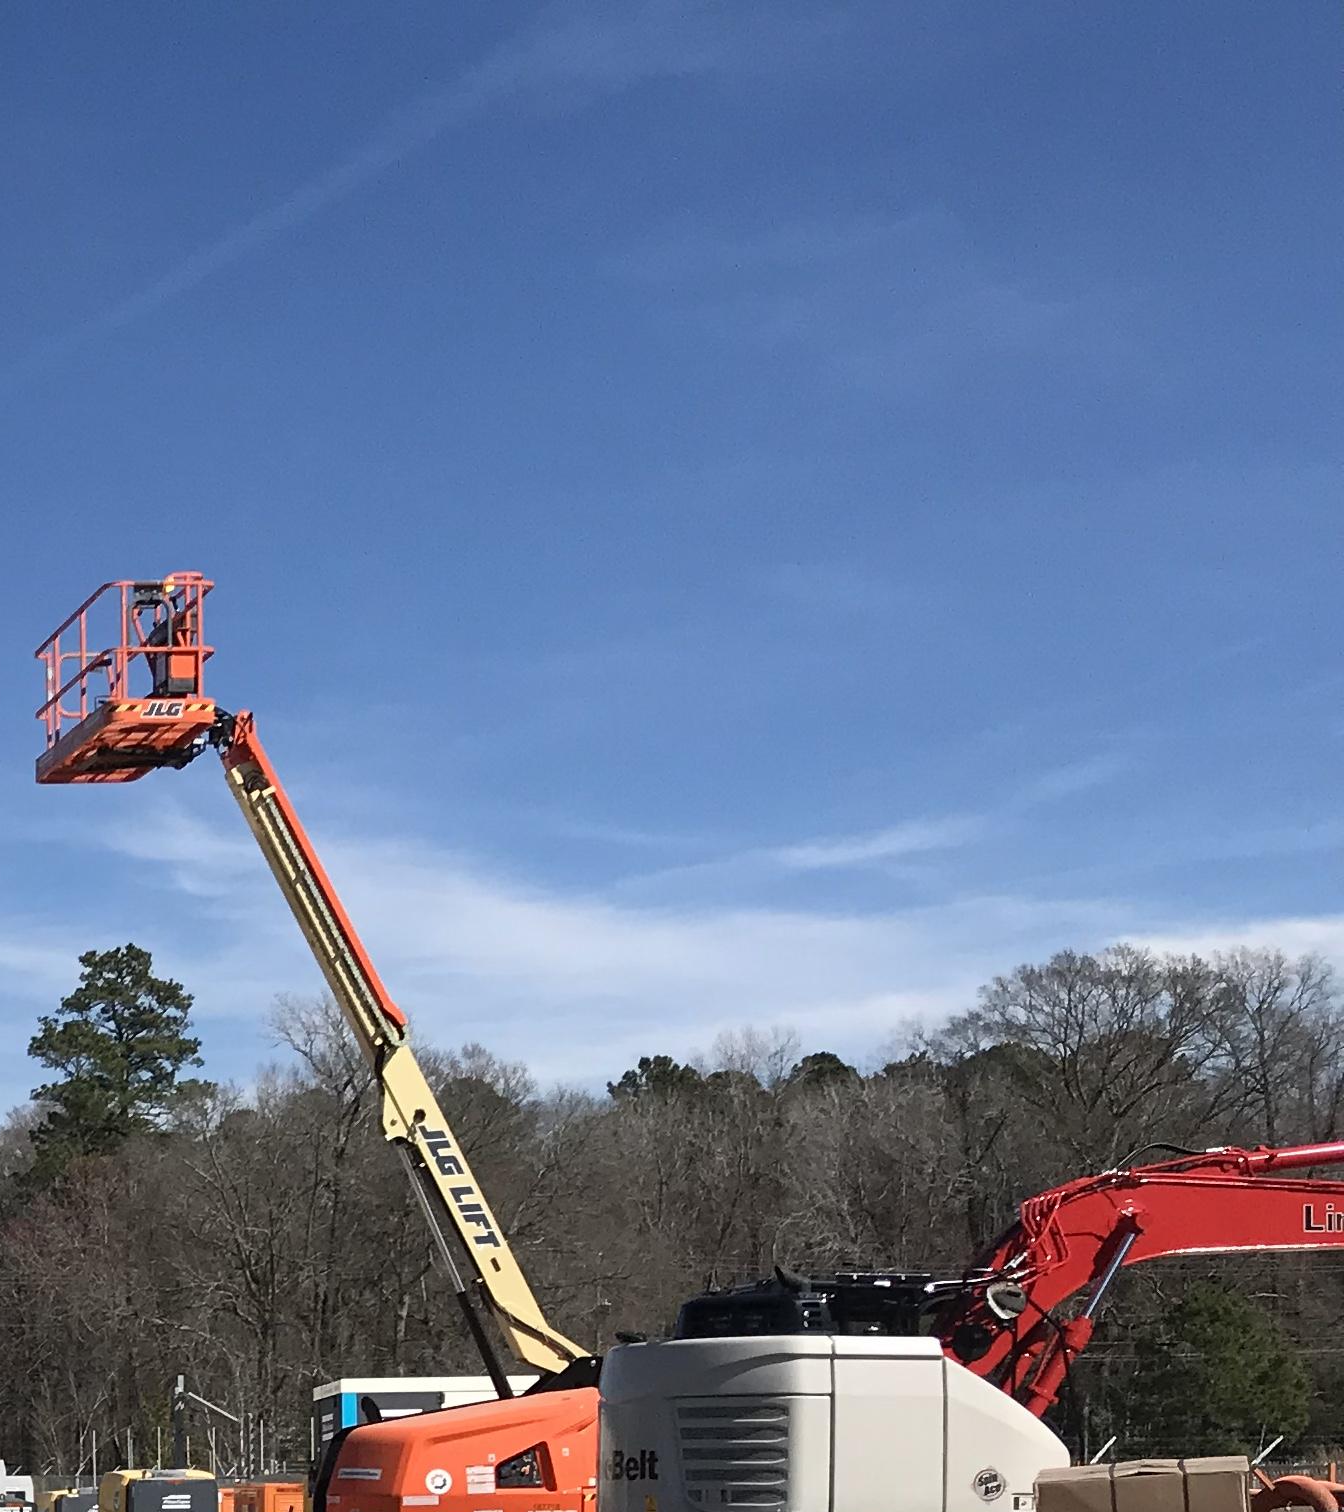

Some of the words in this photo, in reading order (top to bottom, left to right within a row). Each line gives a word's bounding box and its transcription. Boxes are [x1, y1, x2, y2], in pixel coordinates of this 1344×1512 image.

[141, 701, 183, 717] JLG
[418, 1123, 464, 1176] JLG
[449, 1186, 501, 1248] LIFT
